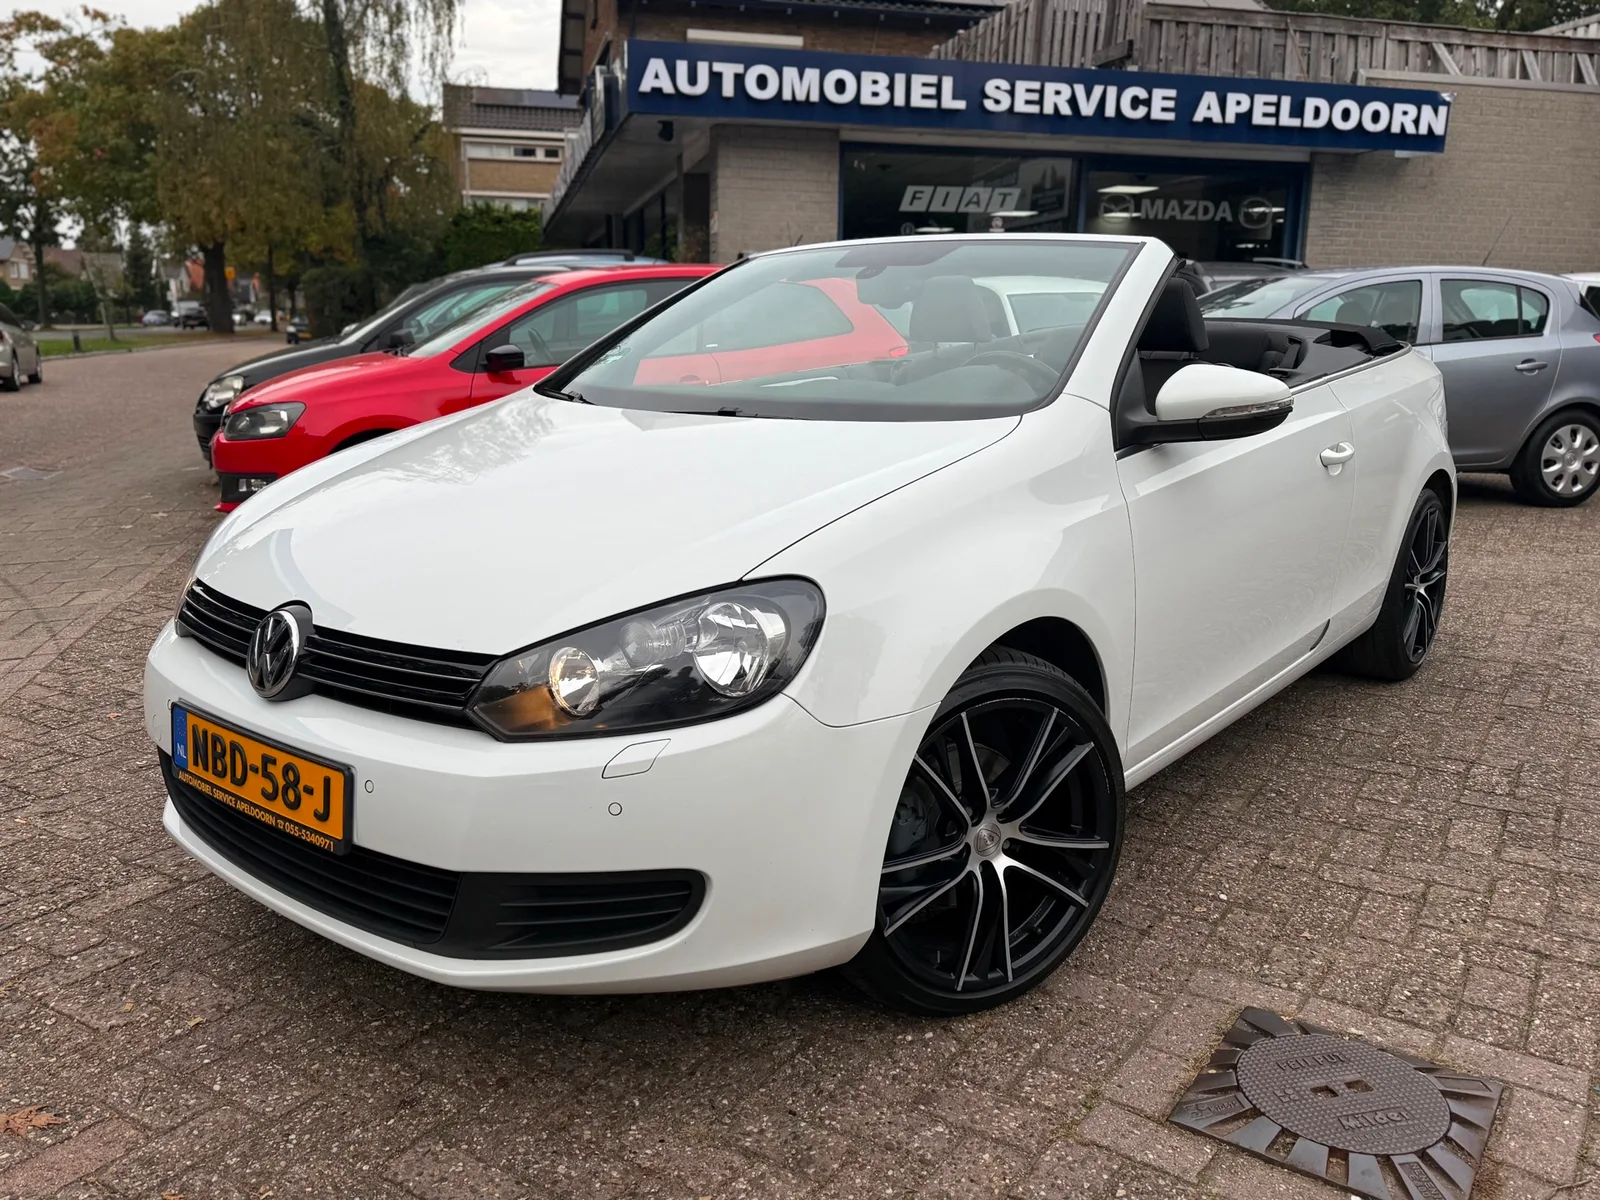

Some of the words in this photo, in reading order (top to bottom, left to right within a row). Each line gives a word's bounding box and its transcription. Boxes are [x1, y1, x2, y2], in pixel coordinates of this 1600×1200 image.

[638, 57, 967, 111] AUTOMOBIEL
[983, 78, 1176, 122] SERVICE
[1192, 91, 1449, 136] APELDOORN
[905, 188, 1016, 210] FIAT
[1139, 198, 1233, 222] MAZDA
[176, 743, 187, 759] NL
[191, 723, 331, 823] NBD-58-J
[178, 770, 213, 796] AUTOMOBIEL
[213, 789, 236, 807] SERVICE
[236, 800, 276, 826] APELDOORN
[284, 819, 335, 852] 055-5340971
